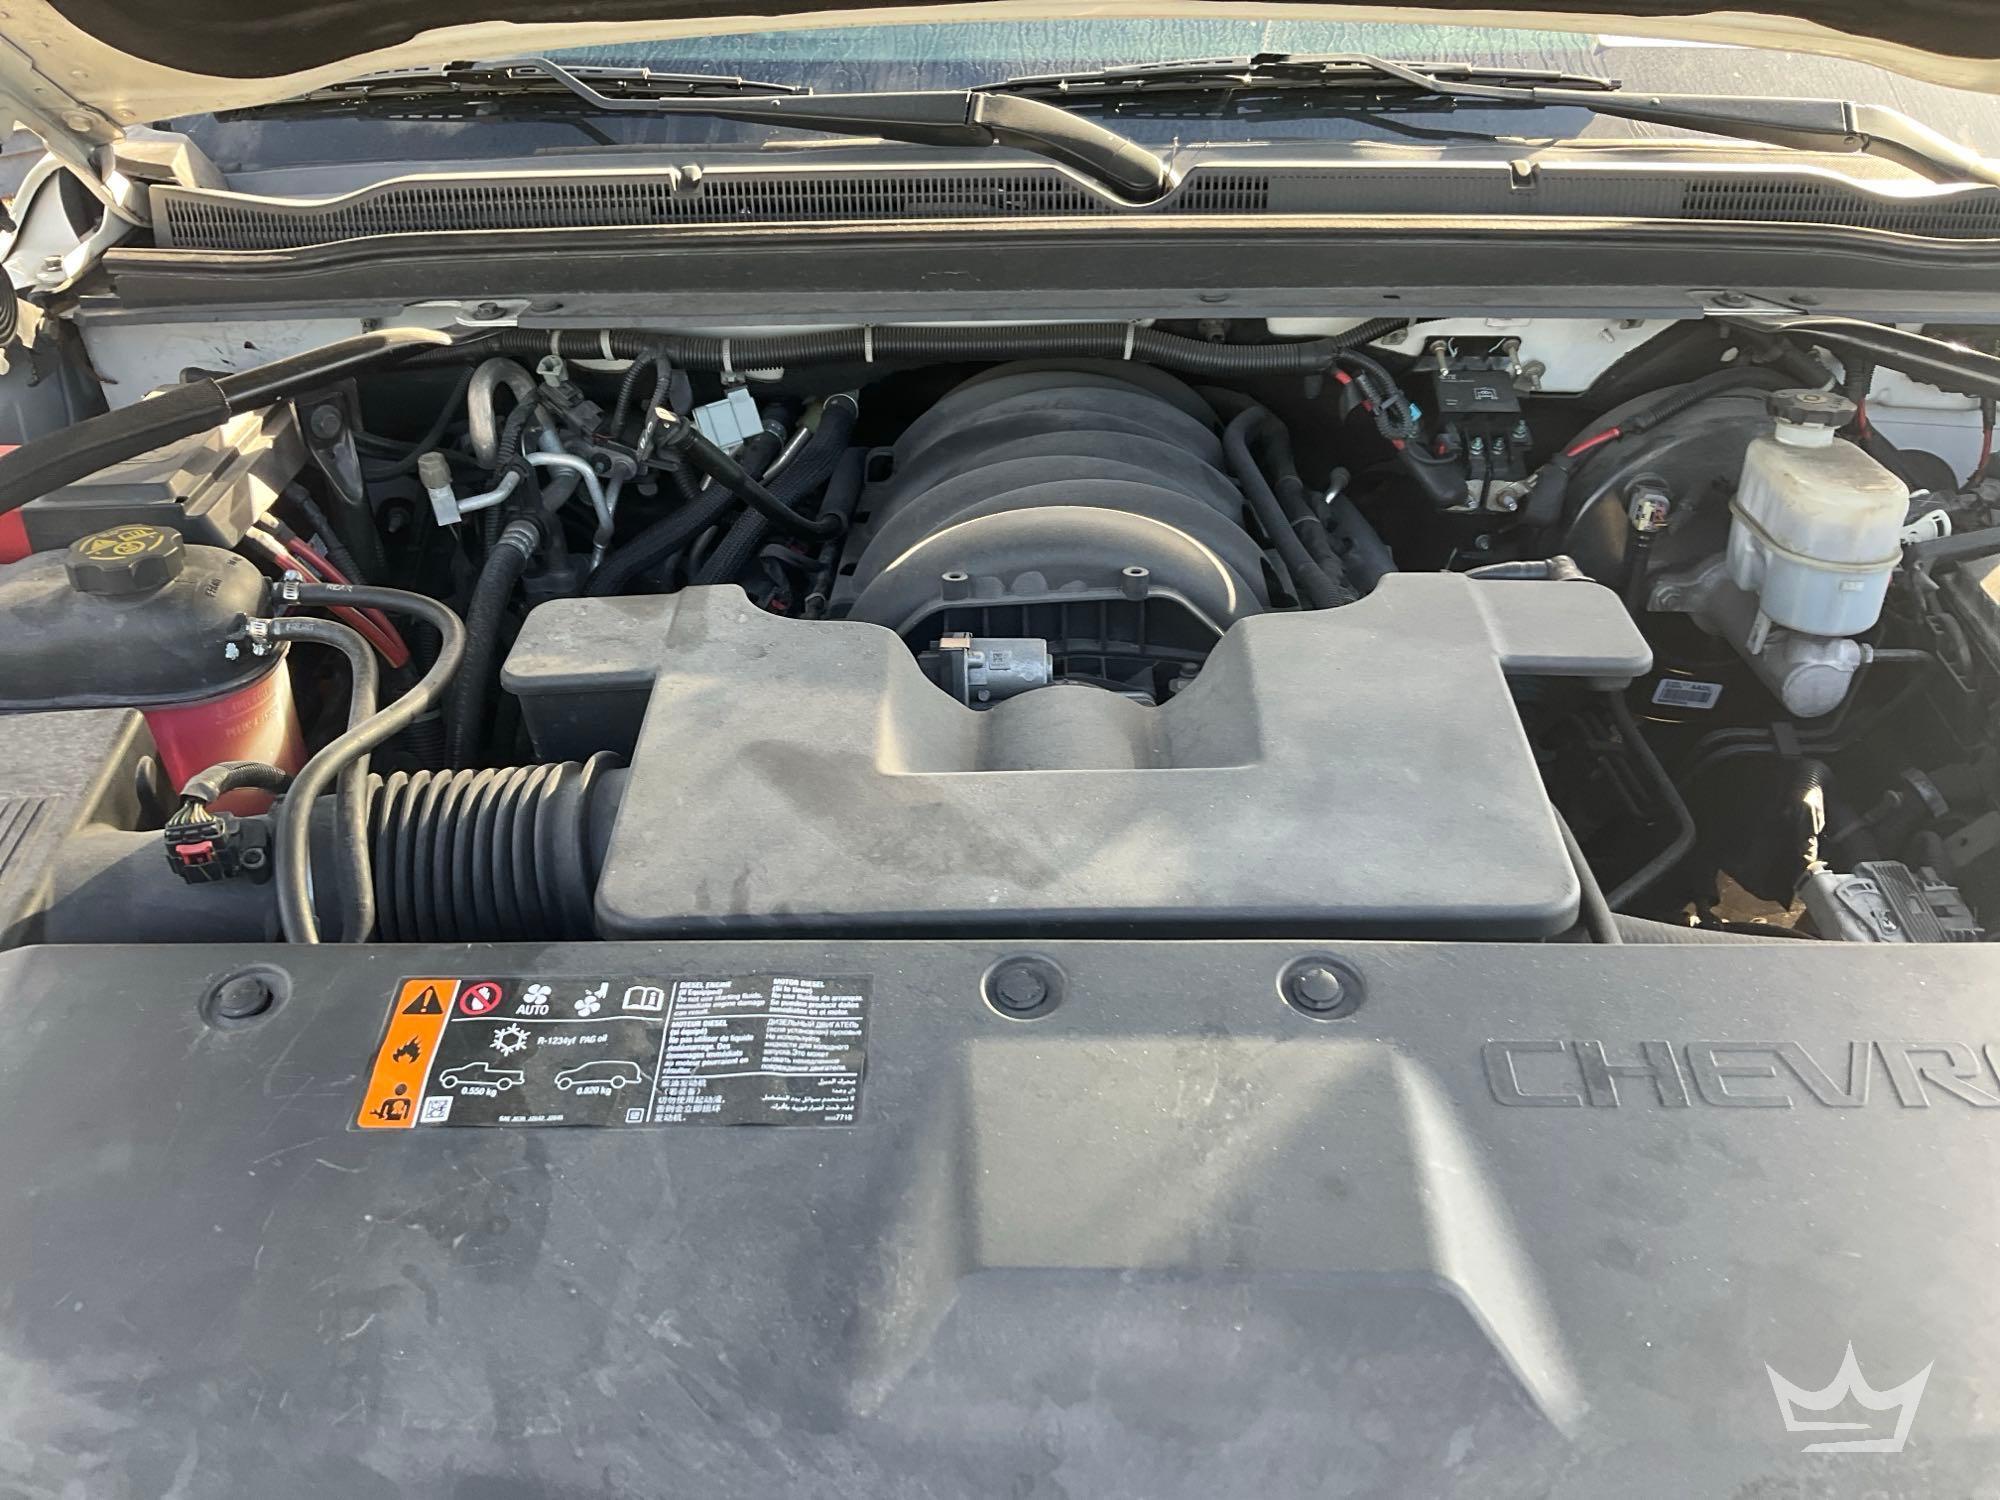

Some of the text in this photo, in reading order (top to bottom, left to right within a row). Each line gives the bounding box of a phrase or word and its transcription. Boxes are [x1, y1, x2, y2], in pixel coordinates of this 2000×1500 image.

[515, 1004, 549, 1015] AUTO
[1483, 1039, 2000, 1108] CHEVR
[486, 1088, 498, 1097] kg
[601, 1086, 612, 1096] kg
